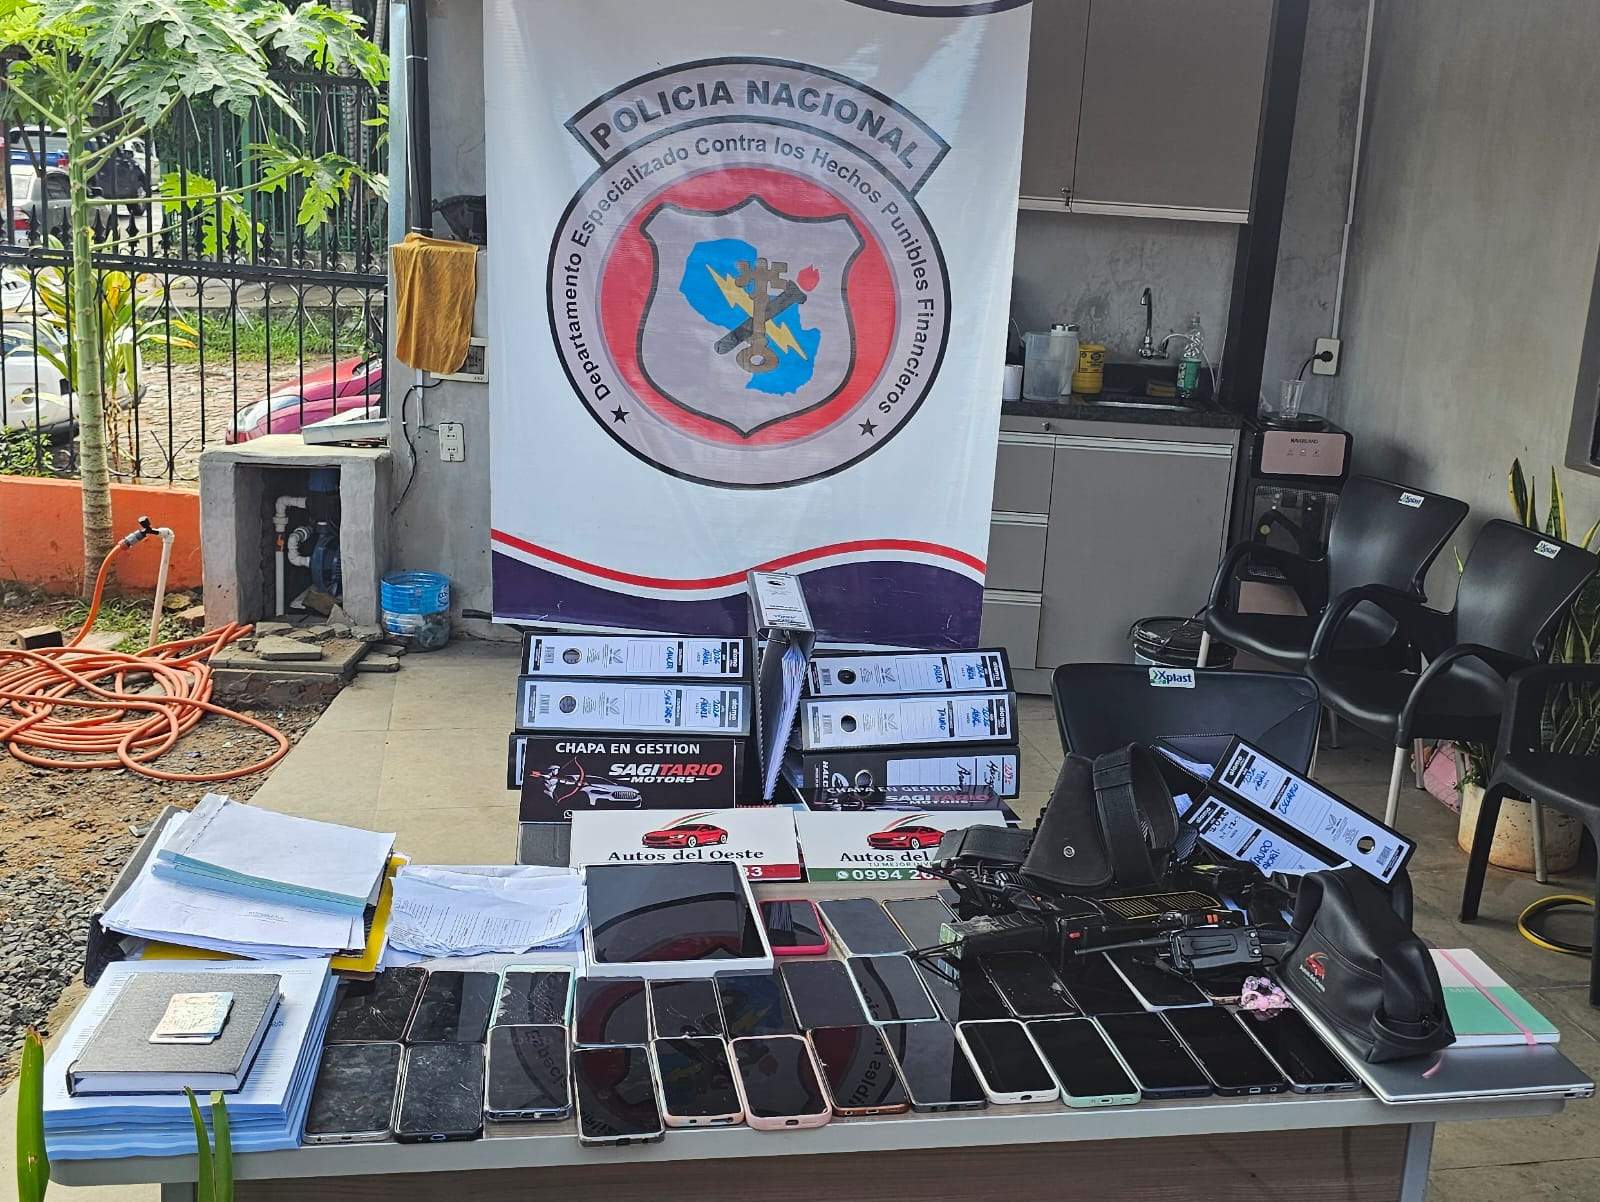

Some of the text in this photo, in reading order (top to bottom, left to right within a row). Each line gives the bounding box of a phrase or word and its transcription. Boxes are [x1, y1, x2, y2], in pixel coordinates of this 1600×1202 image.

[590, 80, 923, 169] POLICIA NACIONAL
[564, 134, 934, 414] Departamento Especializado Contra los Hechos Punibles Financieros
[555, 742, 700, 754] CHAPA EN GESTION
[609, 763, 724, 776] SAGITARIO
[827, 786, 875, 795] CHAPA
[901, 785, 963, 793] GESTION
[886, 794, 989, 802] SAGITARIO
[608, 849, 764, 862] Autos del Oeste
[840, 851, 929, 863] Autos del
[853, 869, 903, 881] 0994
[908, 868, 942, 881] 26
